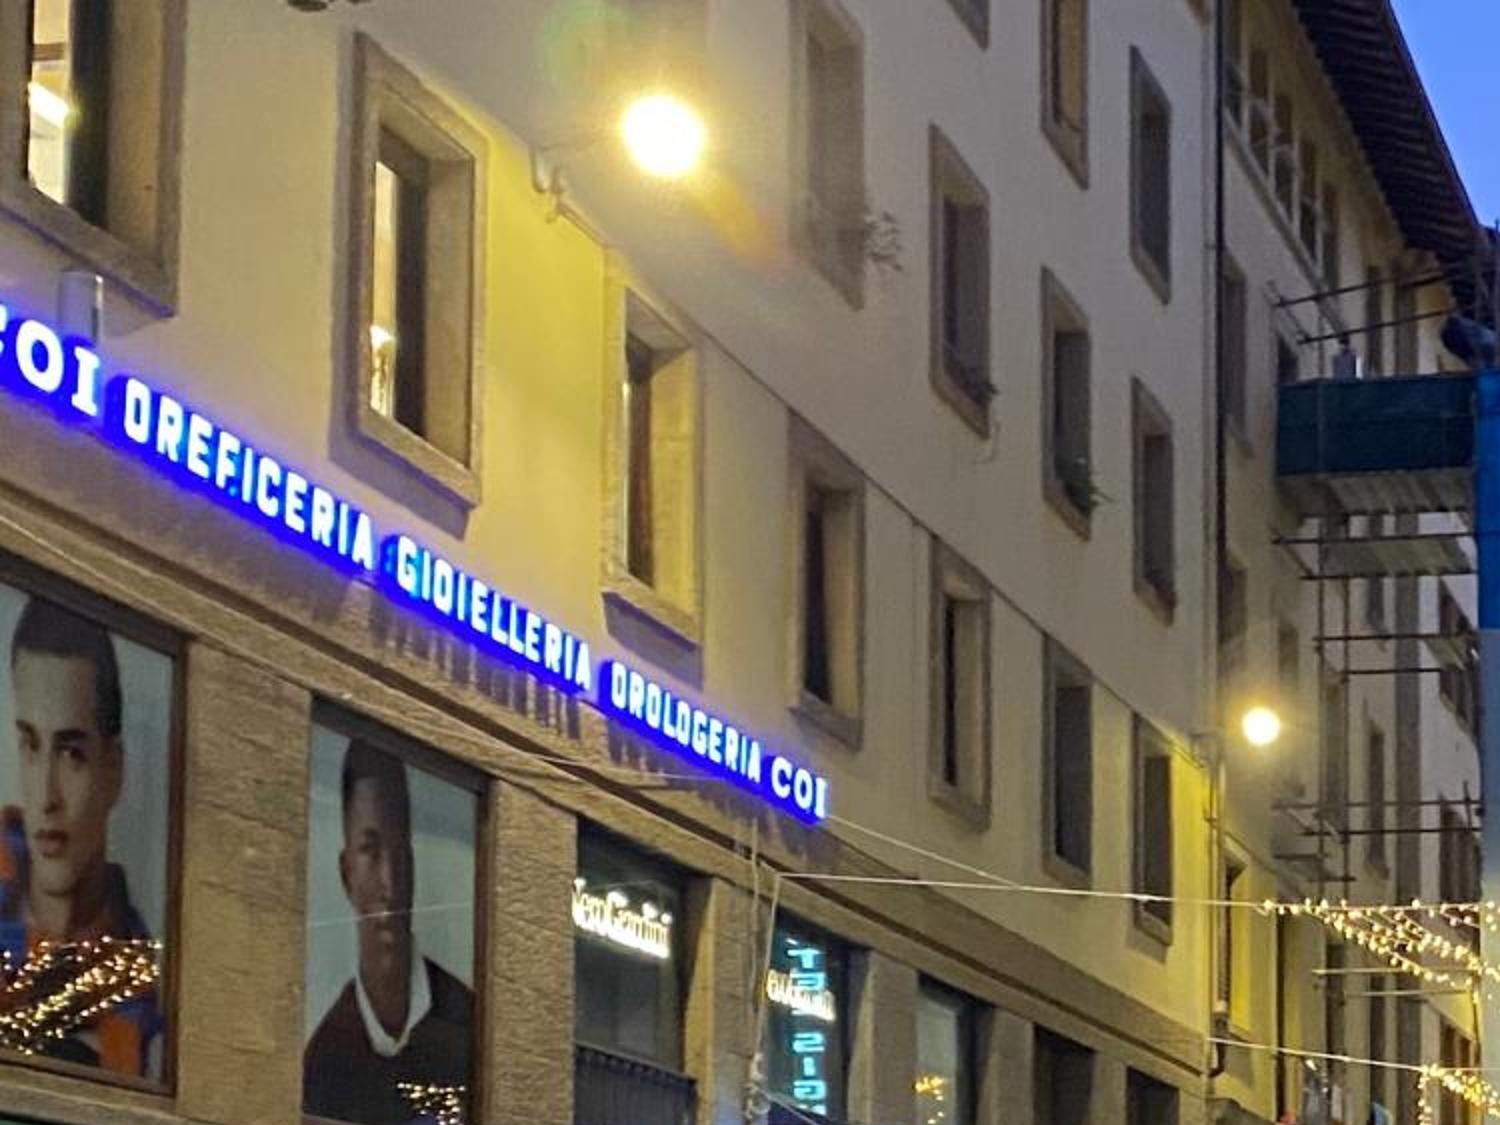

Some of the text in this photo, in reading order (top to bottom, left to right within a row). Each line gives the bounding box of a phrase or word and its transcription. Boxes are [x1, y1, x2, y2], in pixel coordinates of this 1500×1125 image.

[0, 304, 828, 819] OI OREFICERIA GIOIELLERIA OROLOGERIA COI
